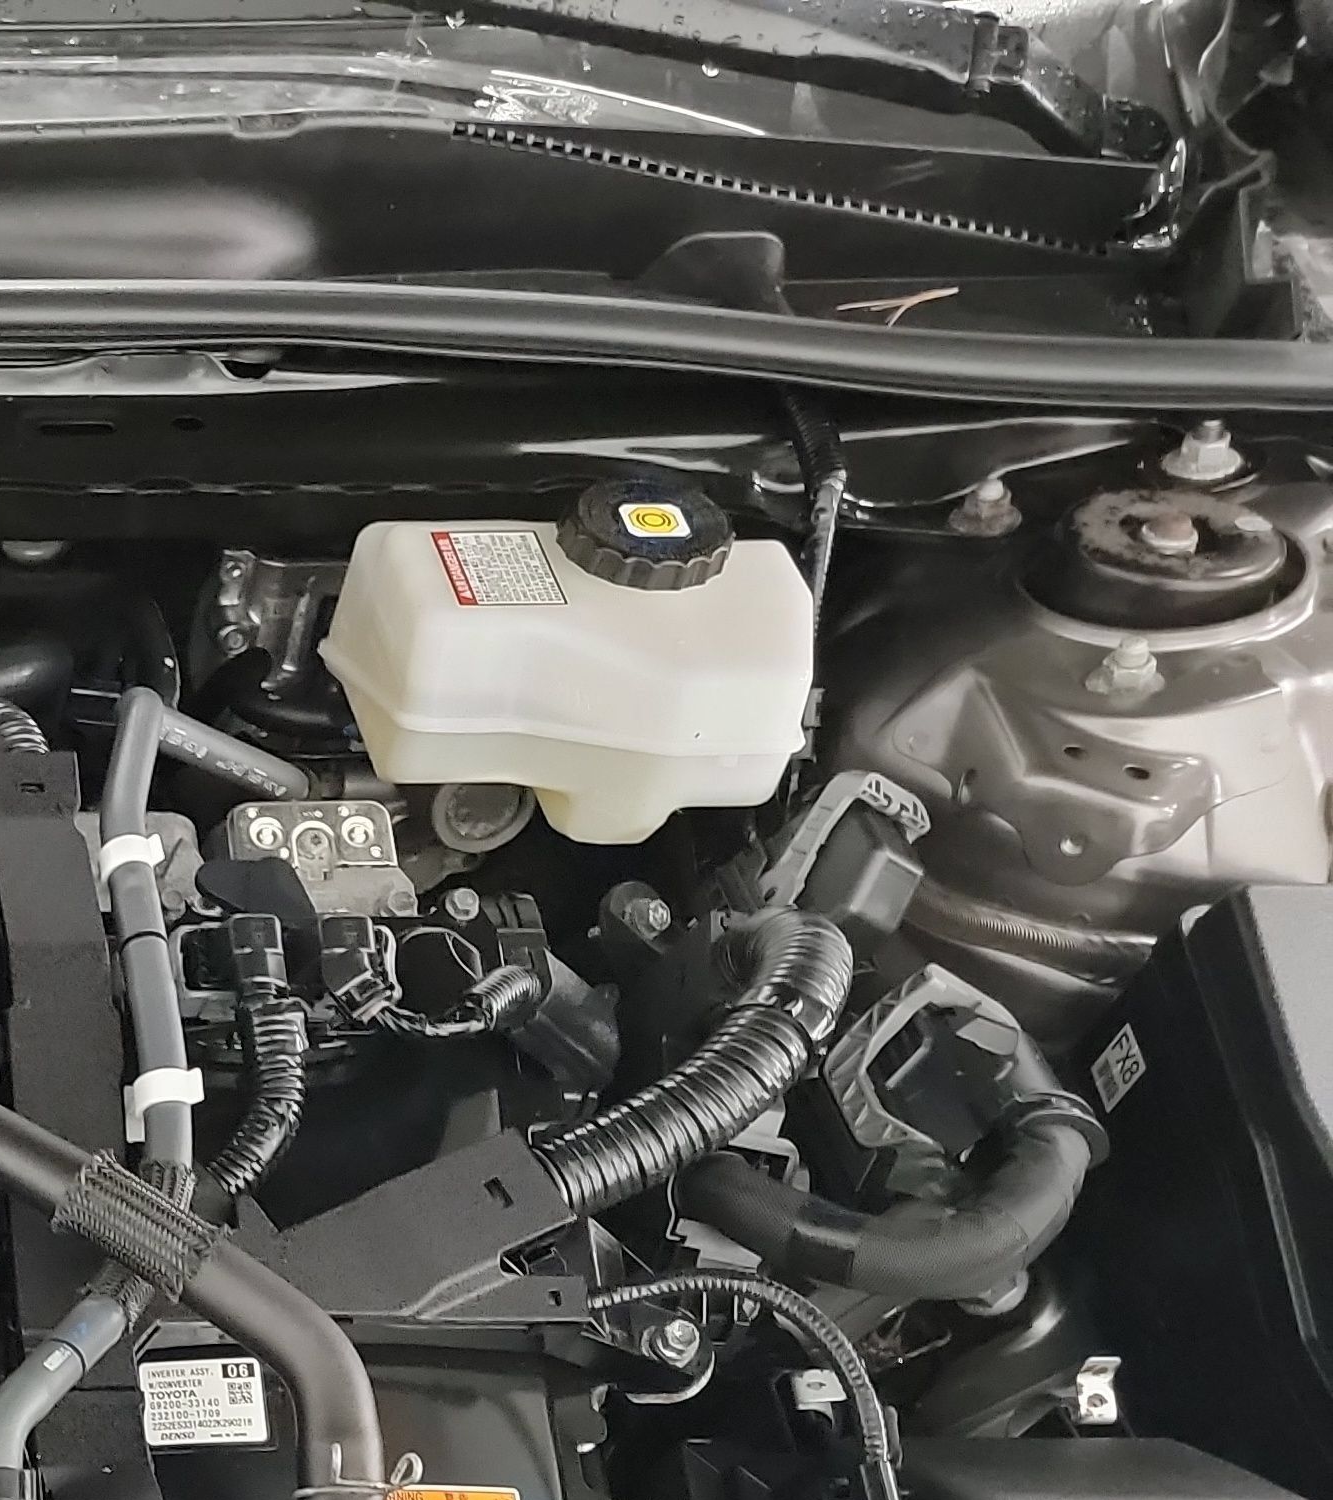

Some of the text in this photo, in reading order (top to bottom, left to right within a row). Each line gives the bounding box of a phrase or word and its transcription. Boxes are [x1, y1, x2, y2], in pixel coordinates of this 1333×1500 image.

[1112, 1033, 1139, 1084] FX8
[148, 1368, 185, 1379] INVERTER
[227, 1364, 249, 1377] 06
[149, 1390, 197, 1400] TOYOTA
[151, 1409, 221, 1420] 232100-1709
[161, 1431, 195, 1440] DENSO
